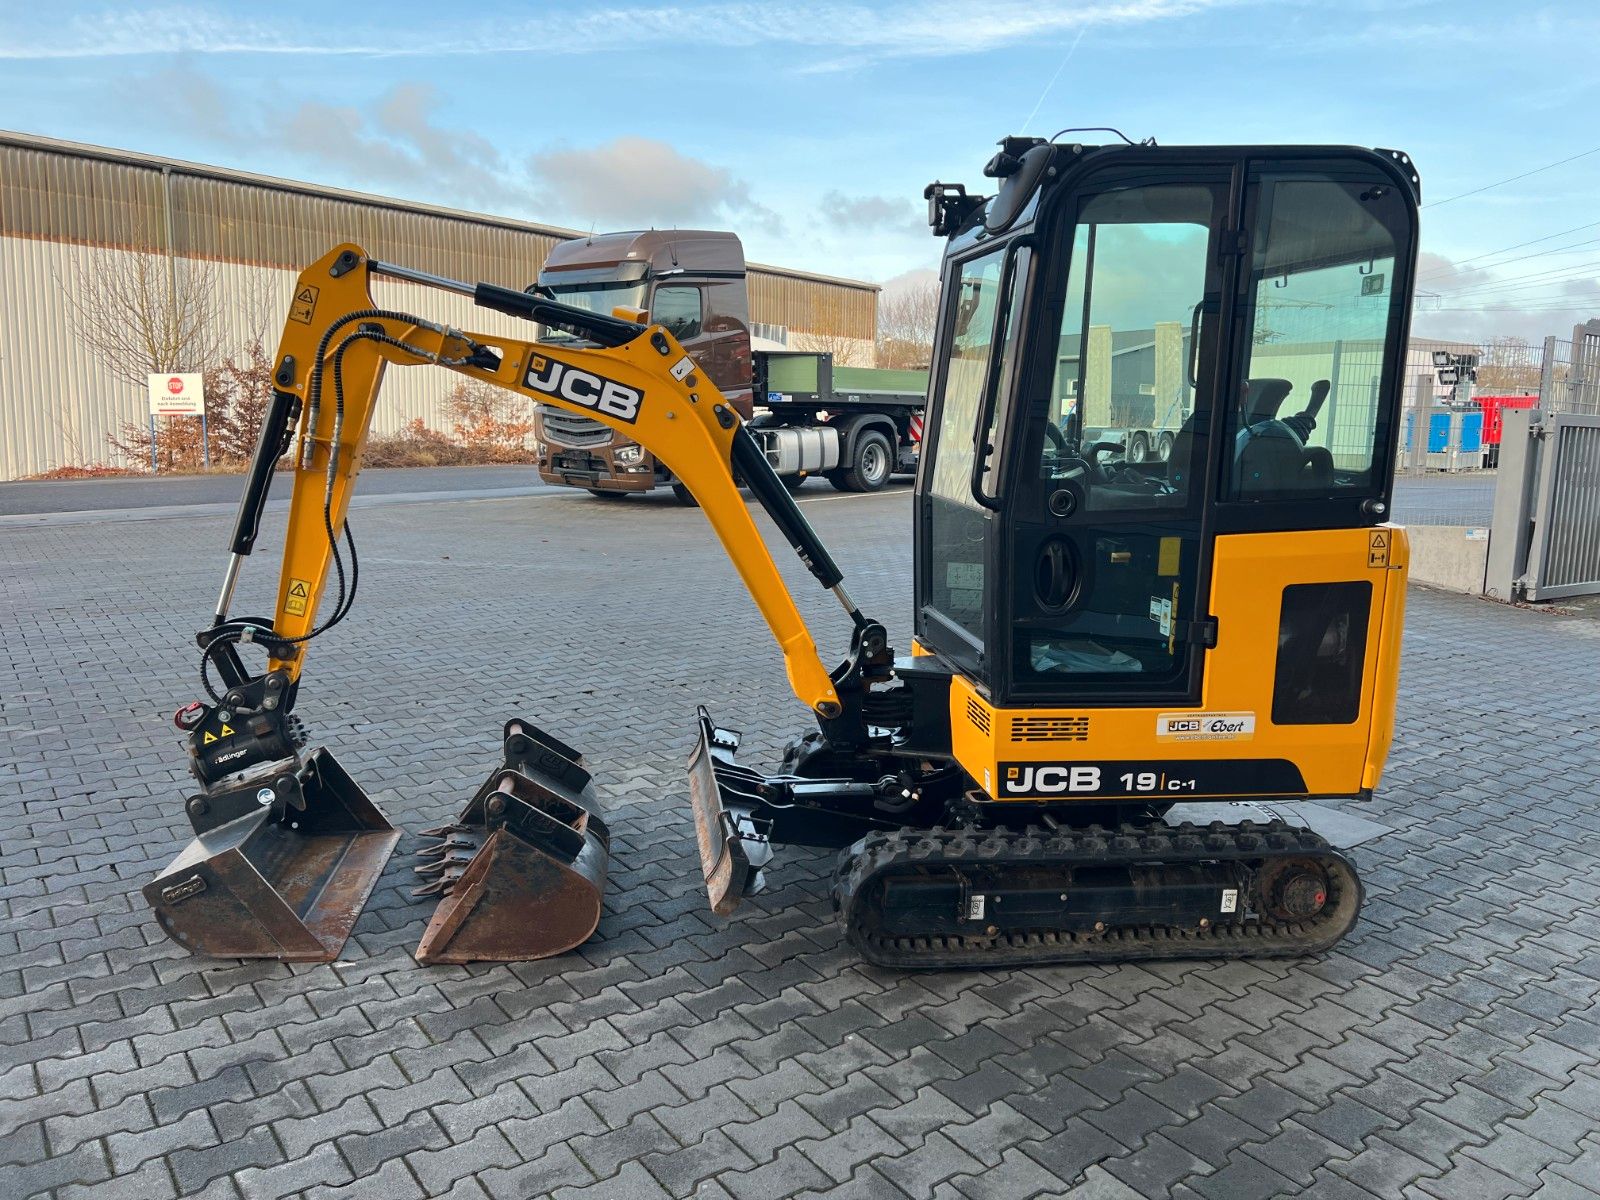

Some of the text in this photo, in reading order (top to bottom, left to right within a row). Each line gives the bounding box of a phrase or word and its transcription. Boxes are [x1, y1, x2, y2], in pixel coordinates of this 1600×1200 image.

[168, 382, 183, 390] STOP
[527, 361, 640, 420] JCB
[1169, 720, 1244, 732] JCB Ebert
[1006, 766, 1101, 793] JCB
[1119, 772, 1157, 791] 19
